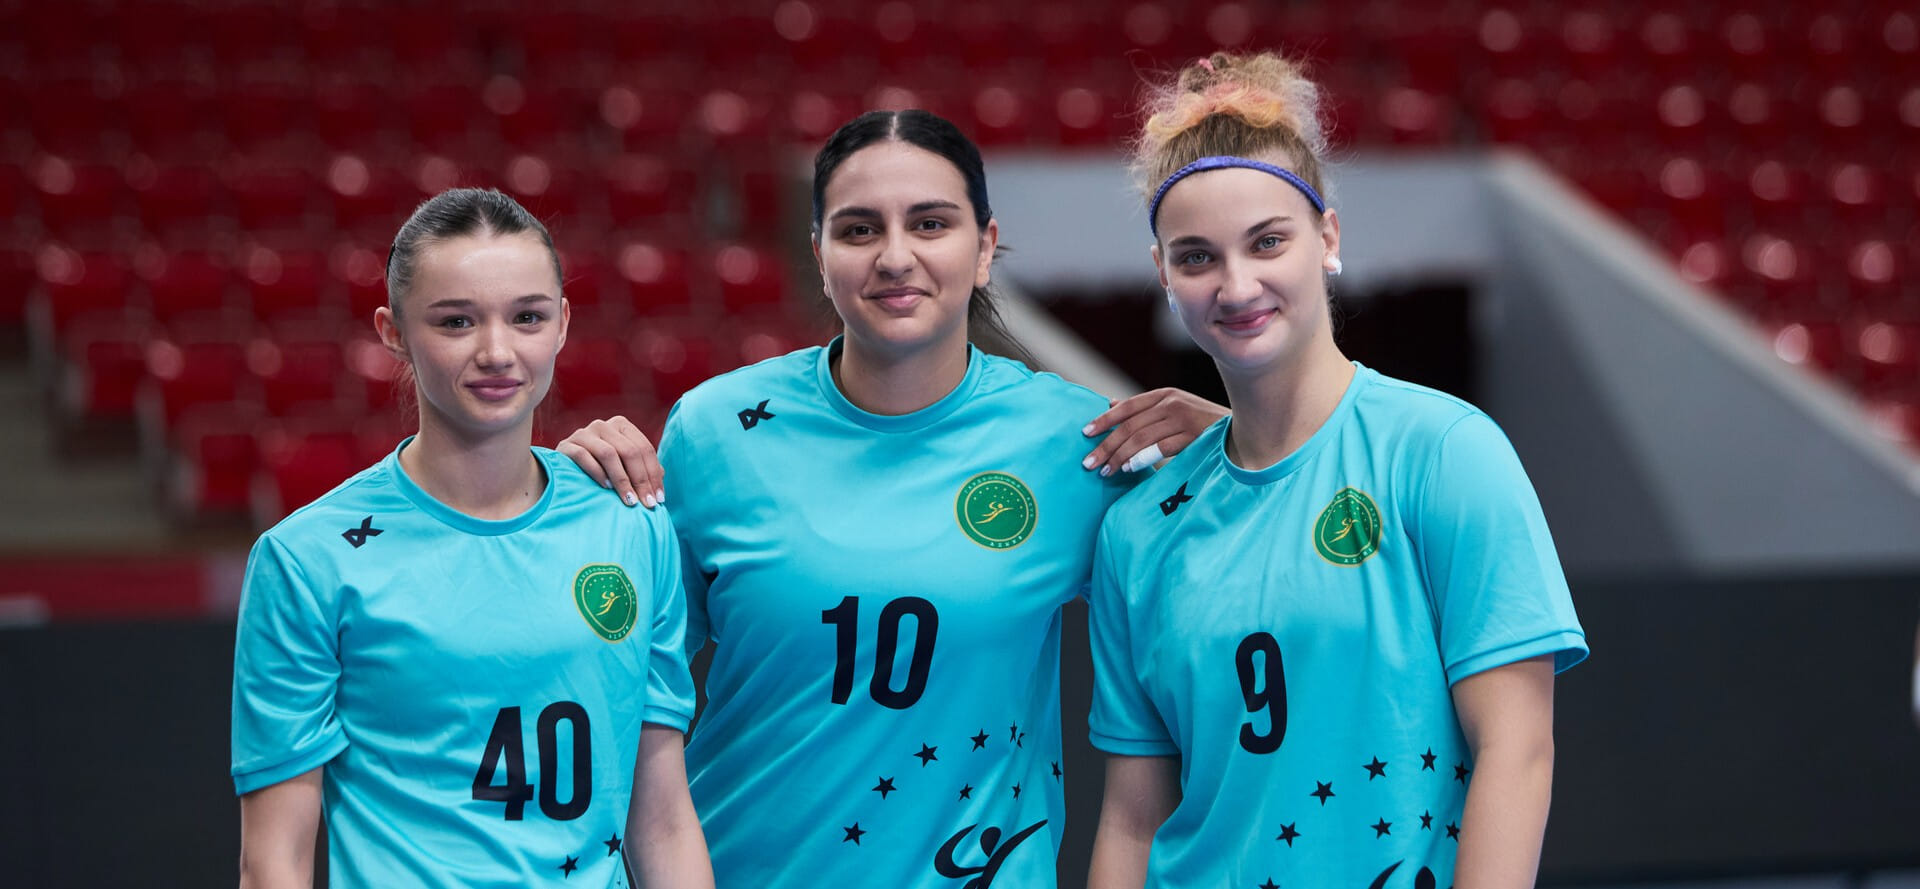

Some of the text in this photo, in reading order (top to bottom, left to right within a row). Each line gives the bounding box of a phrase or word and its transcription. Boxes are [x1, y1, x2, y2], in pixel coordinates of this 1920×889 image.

[822, 596, 938, 709] 10
[1236, 632, 1287, 754] 9
[472, 701, 592, 821] 40
